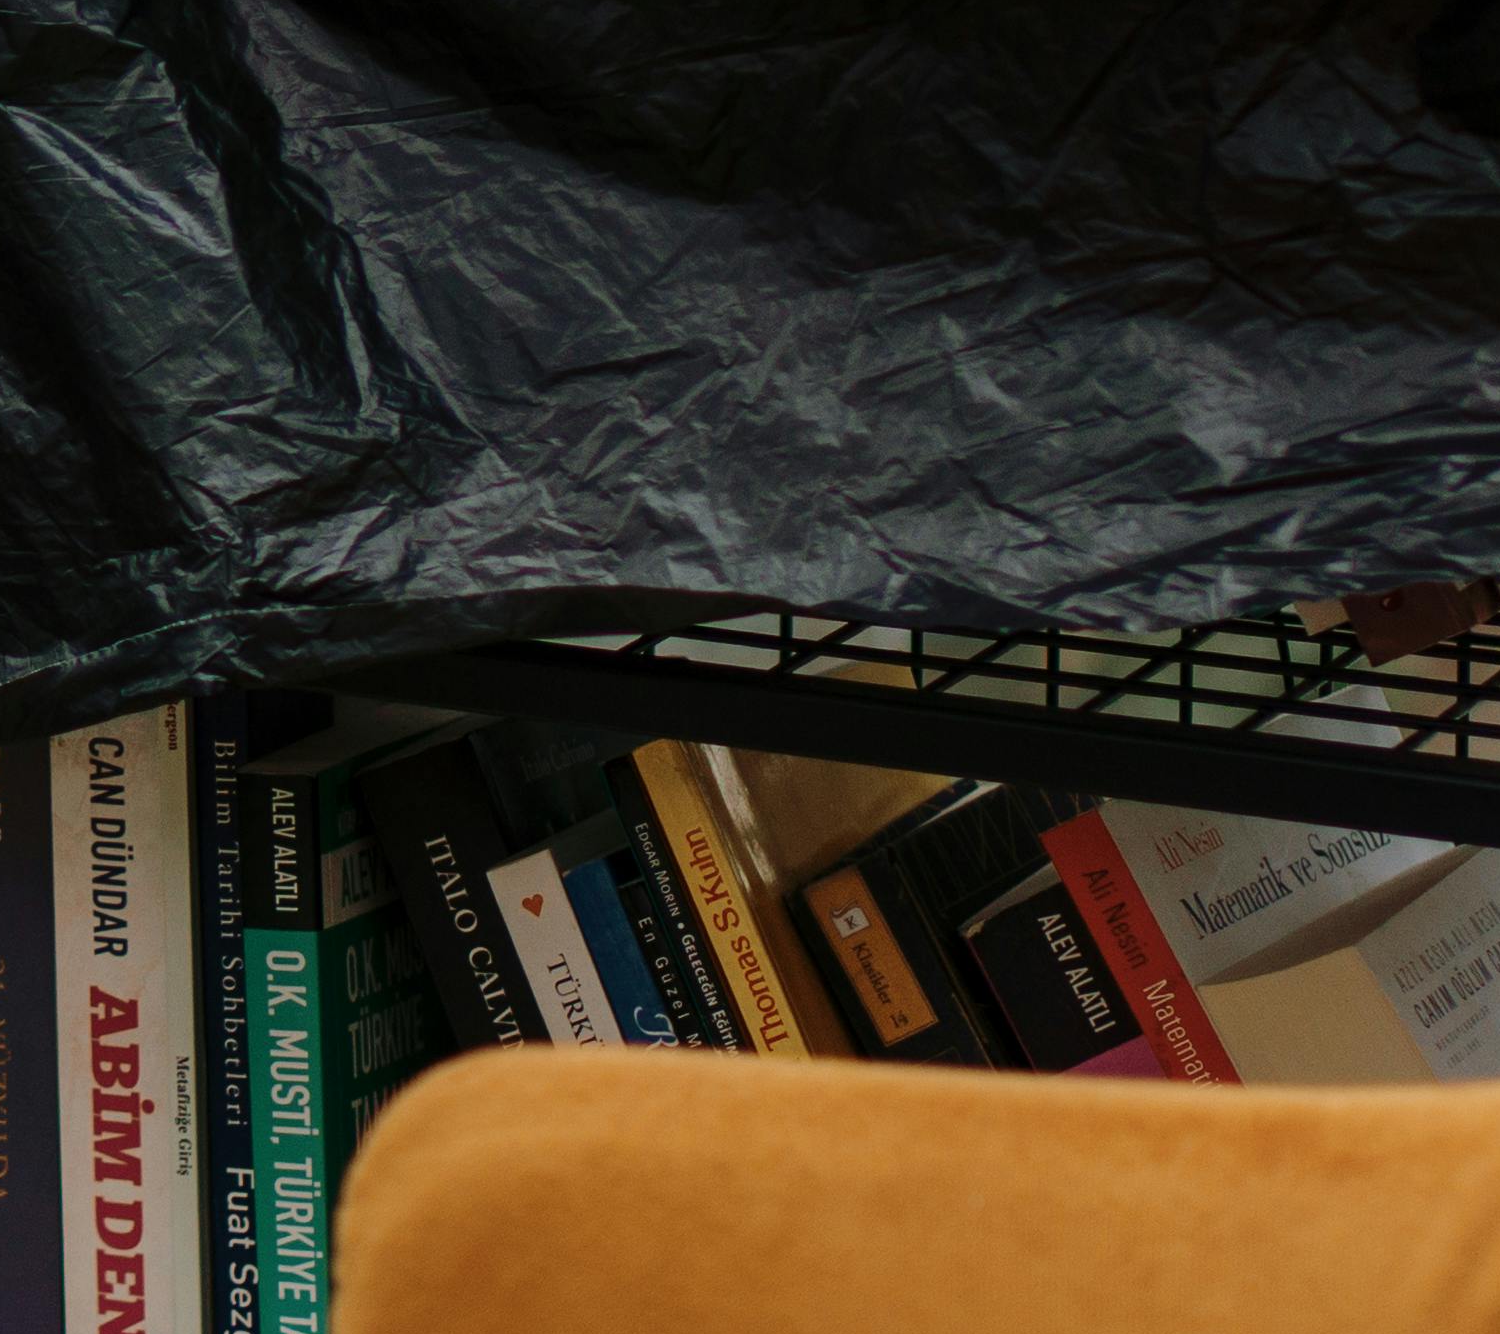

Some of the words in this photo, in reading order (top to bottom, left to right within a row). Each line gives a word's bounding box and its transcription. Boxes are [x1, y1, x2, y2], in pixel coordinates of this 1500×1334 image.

[166, 700, 178, 751] ergson
[88, 736, 126, 807] CAN
[213, 738, 239, 826] Bilim
[270, 787, 298, 839] ALEV
[634, 821, 661, 871] EDGAR
[1152, 835, 1185, 874] Ali
[1176, 821, 1226, 866] Nesin
[90, 817, 135, 958] DÜNDAR
[216, 840, 244, 939] Tarihi
[273, 844, 300, 913] ALATLI
[424, 833, 479, 935] ITALO
[1082, 867, 1121, 902] Ali
[1178, 855, 1294, 942] Matematik
[1287, 856, 1313, 893] ve
[637, 915, 657, 945] En
[654, 955, 692, 1022] Güzel
[1036, 912, 1082, 964] ALEV
[1064, 958, 1118, 1035] ALATLI
[1101, 902, 1151, 971] Nesin
[265, 950, 308, 1016] O.K.
[730, 934, 791, 1053] Thomas
[1412, 983, 1459, 1030] CANIM
[221, 954, 249, 1127] Sohbetleri
[89, 985, 156, 1188] ABİM
[174, 1056, 193, 1133] Metafiziğe
[176, 1136, 194, 1177] Giriş
[224, 1166, 256, 1251] Fuat
[273, 1156, 325, 1304] TÜRKİYE
